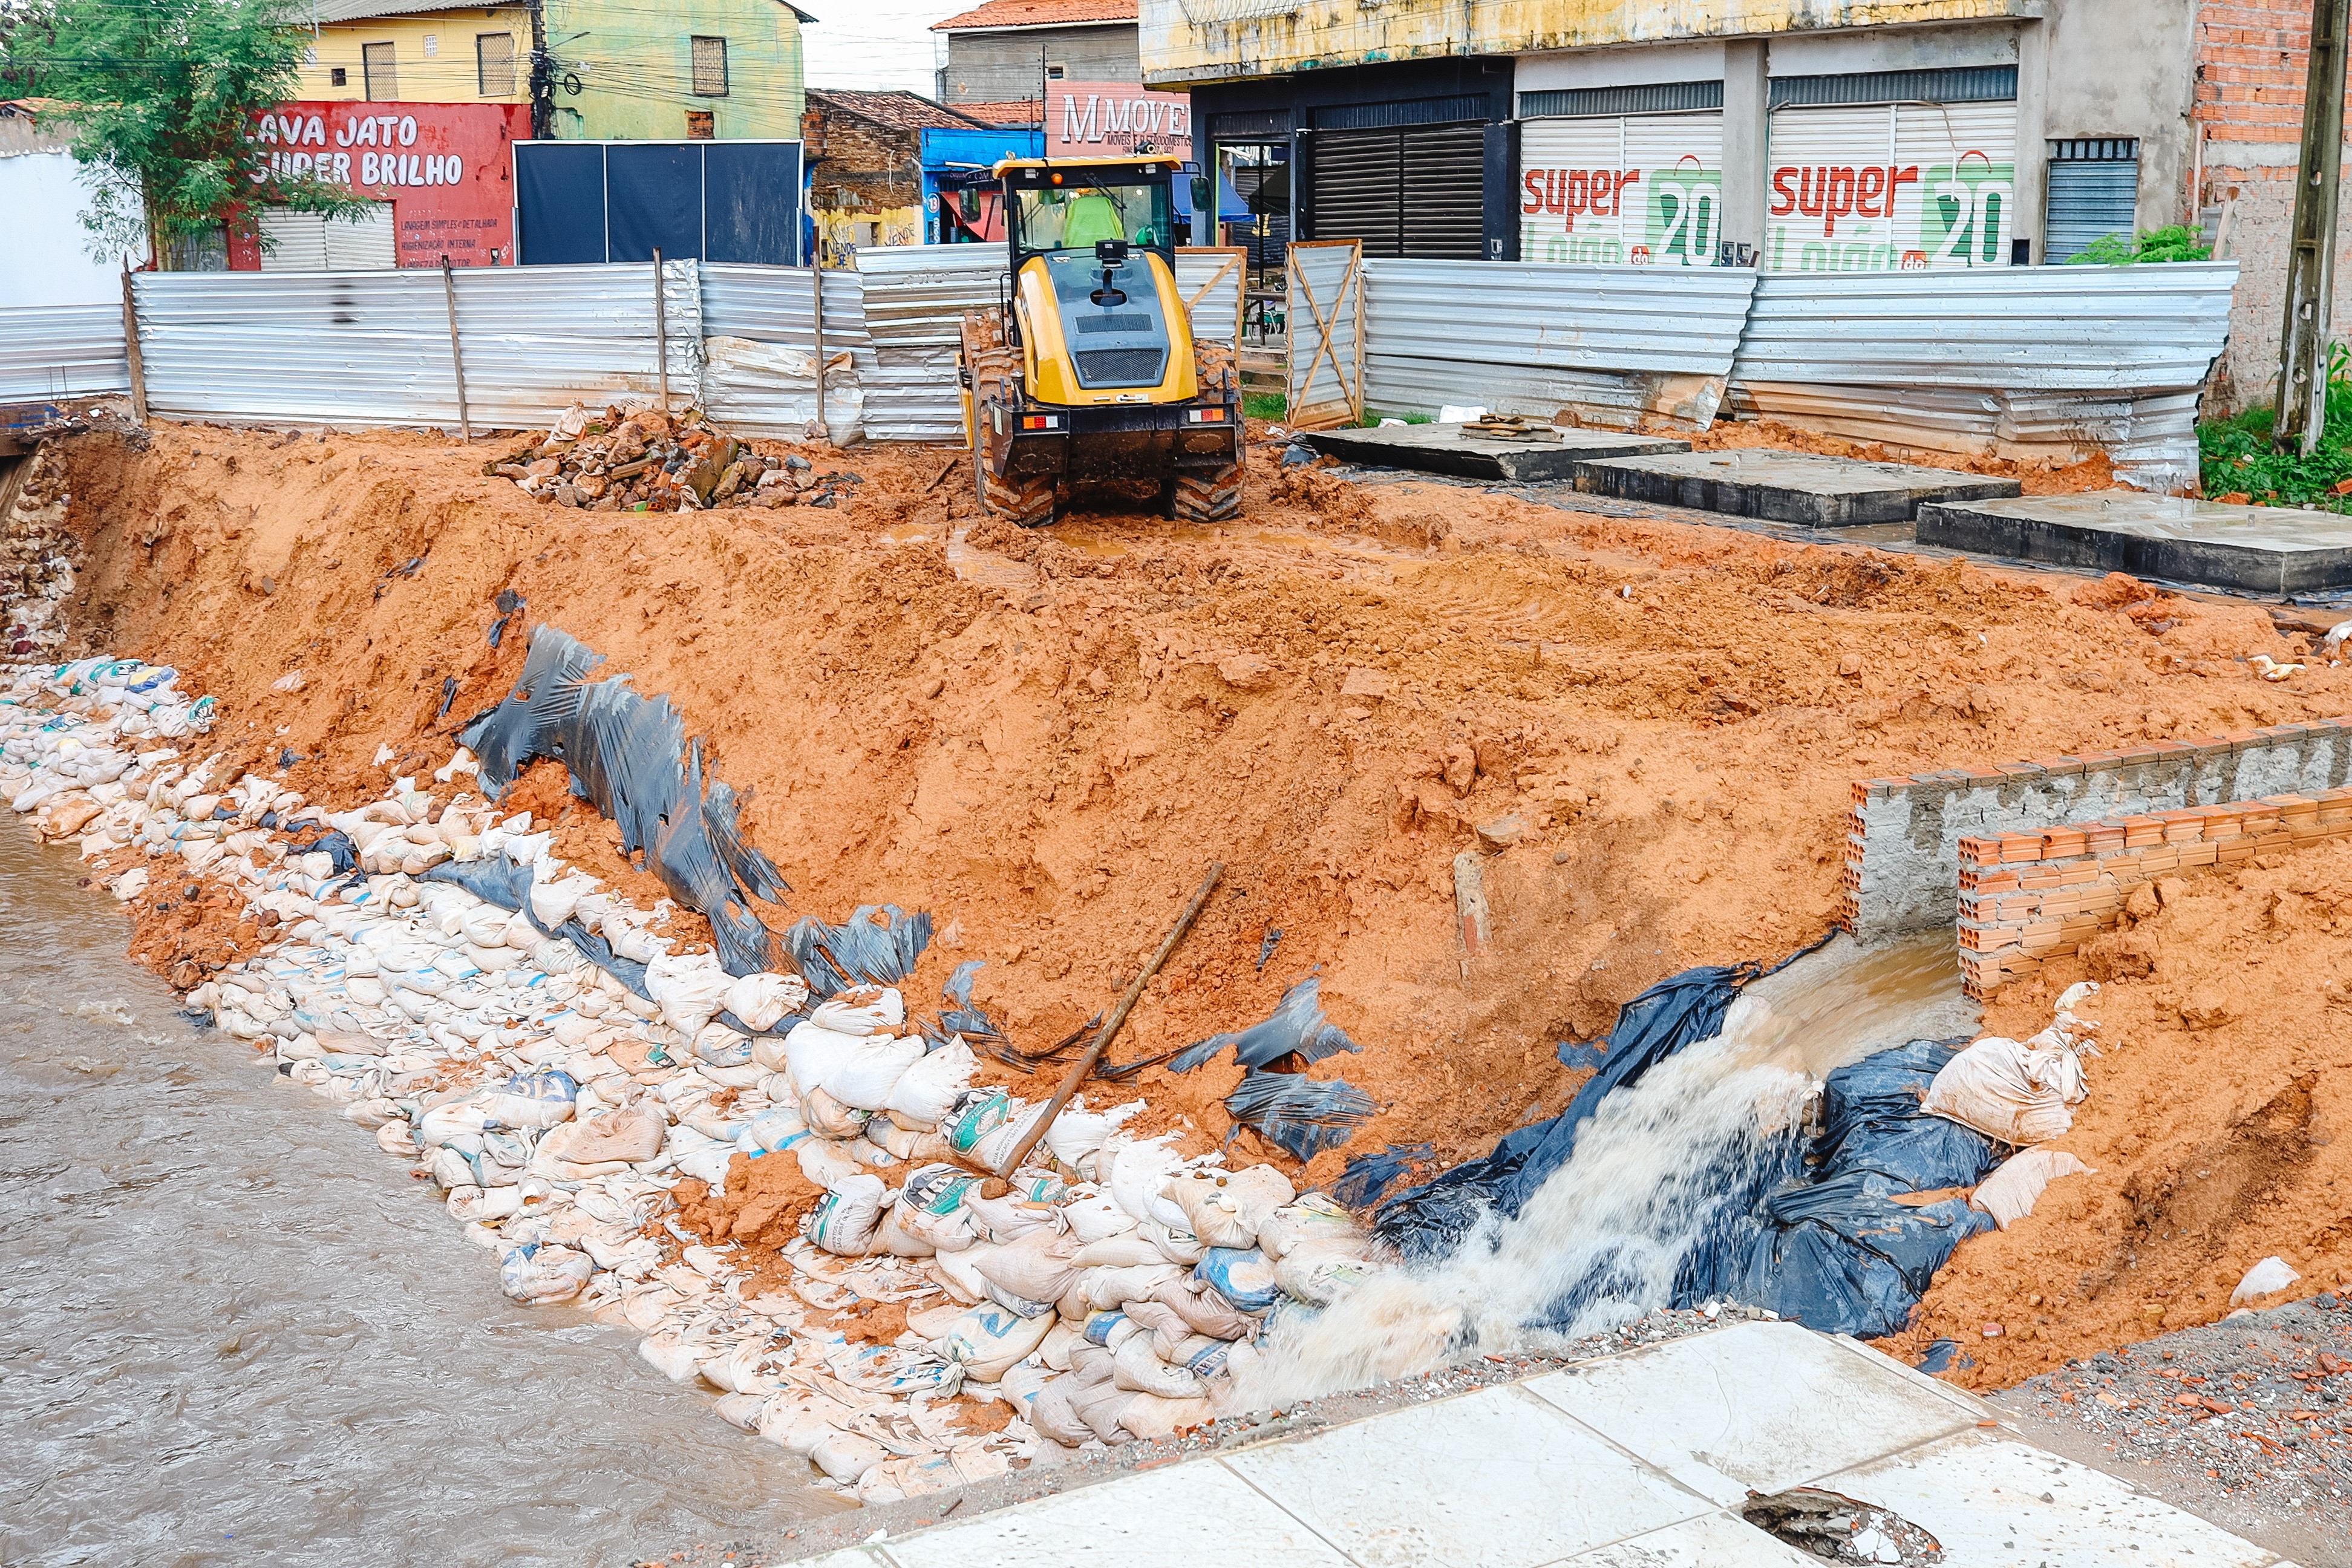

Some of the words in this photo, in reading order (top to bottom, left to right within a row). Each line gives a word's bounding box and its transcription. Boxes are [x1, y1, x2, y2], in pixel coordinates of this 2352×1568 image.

[336, 116, 418, 147] JATO
[248, 151, 351, 184] SUPER
[362, 152, 463, 187] BRILHO
[400, 220, 430, 230] LAVAGEM
[431, 220, 458, 229] SIMPLES
[463, 218, 497, 229] DETALHADA
[1523, 169, 1640, 233] super
[1654, 182, 1722, 266] 20
[1771, 165, 1919, 238] super
[1929, 181, 2014, 269] 20
[447, 239, 476, 249] INTERNA
